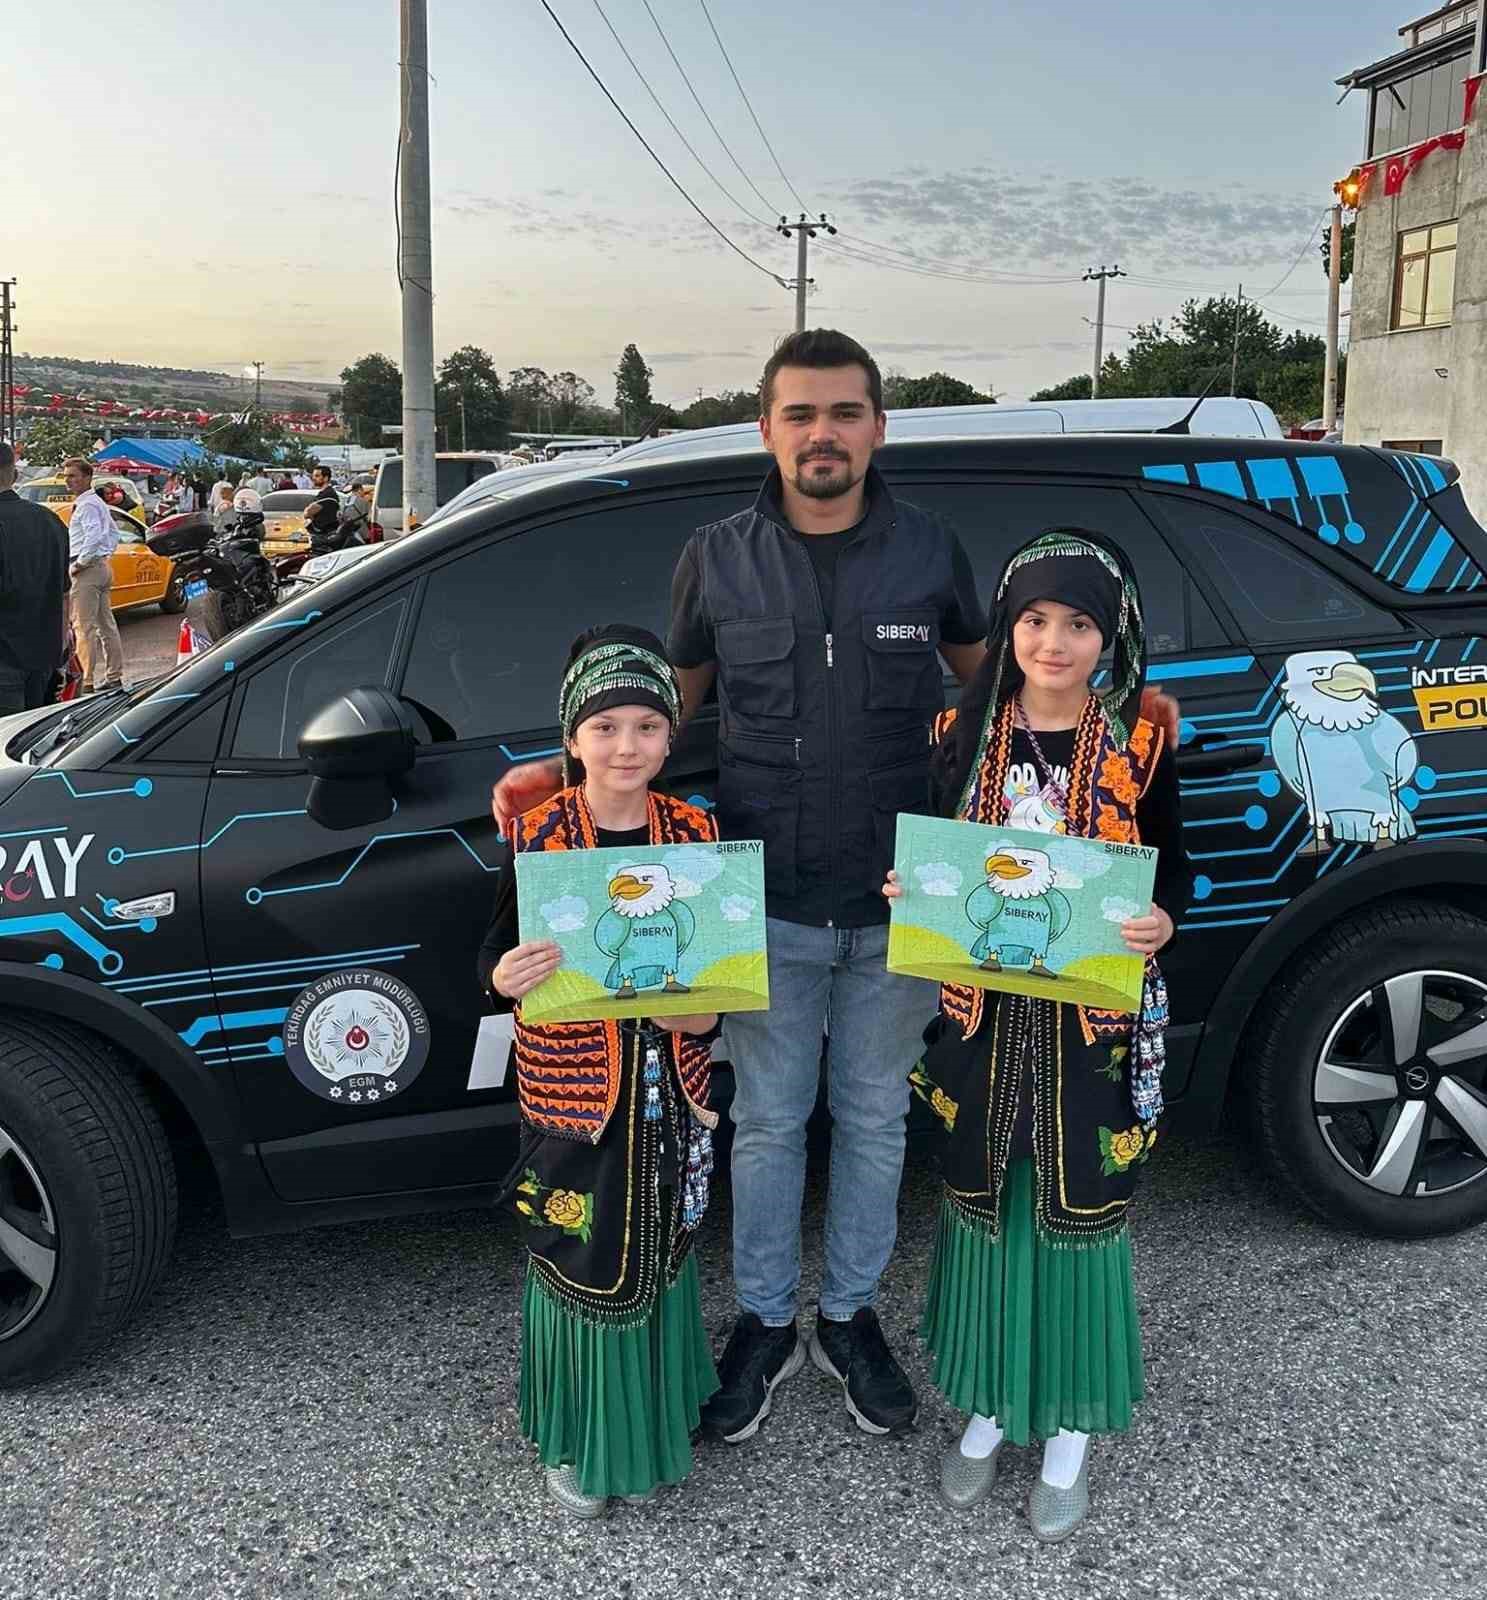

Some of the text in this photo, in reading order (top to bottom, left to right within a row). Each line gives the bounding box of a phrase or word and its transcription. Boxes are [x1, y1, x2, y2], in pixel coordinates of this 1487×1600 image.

[876, 624, 930, 641] SIBERAY
[716, 842, 761, 853] SIBERAY
[1105, 843, 1154, 860] SIBERAY
[0, 834, 96, 899] AY
[1004, 907, 1049, 922] SIBERAY
[632, 926, 674, 937] SIBERAY
[349, 1076, 376, 1088] EGM
